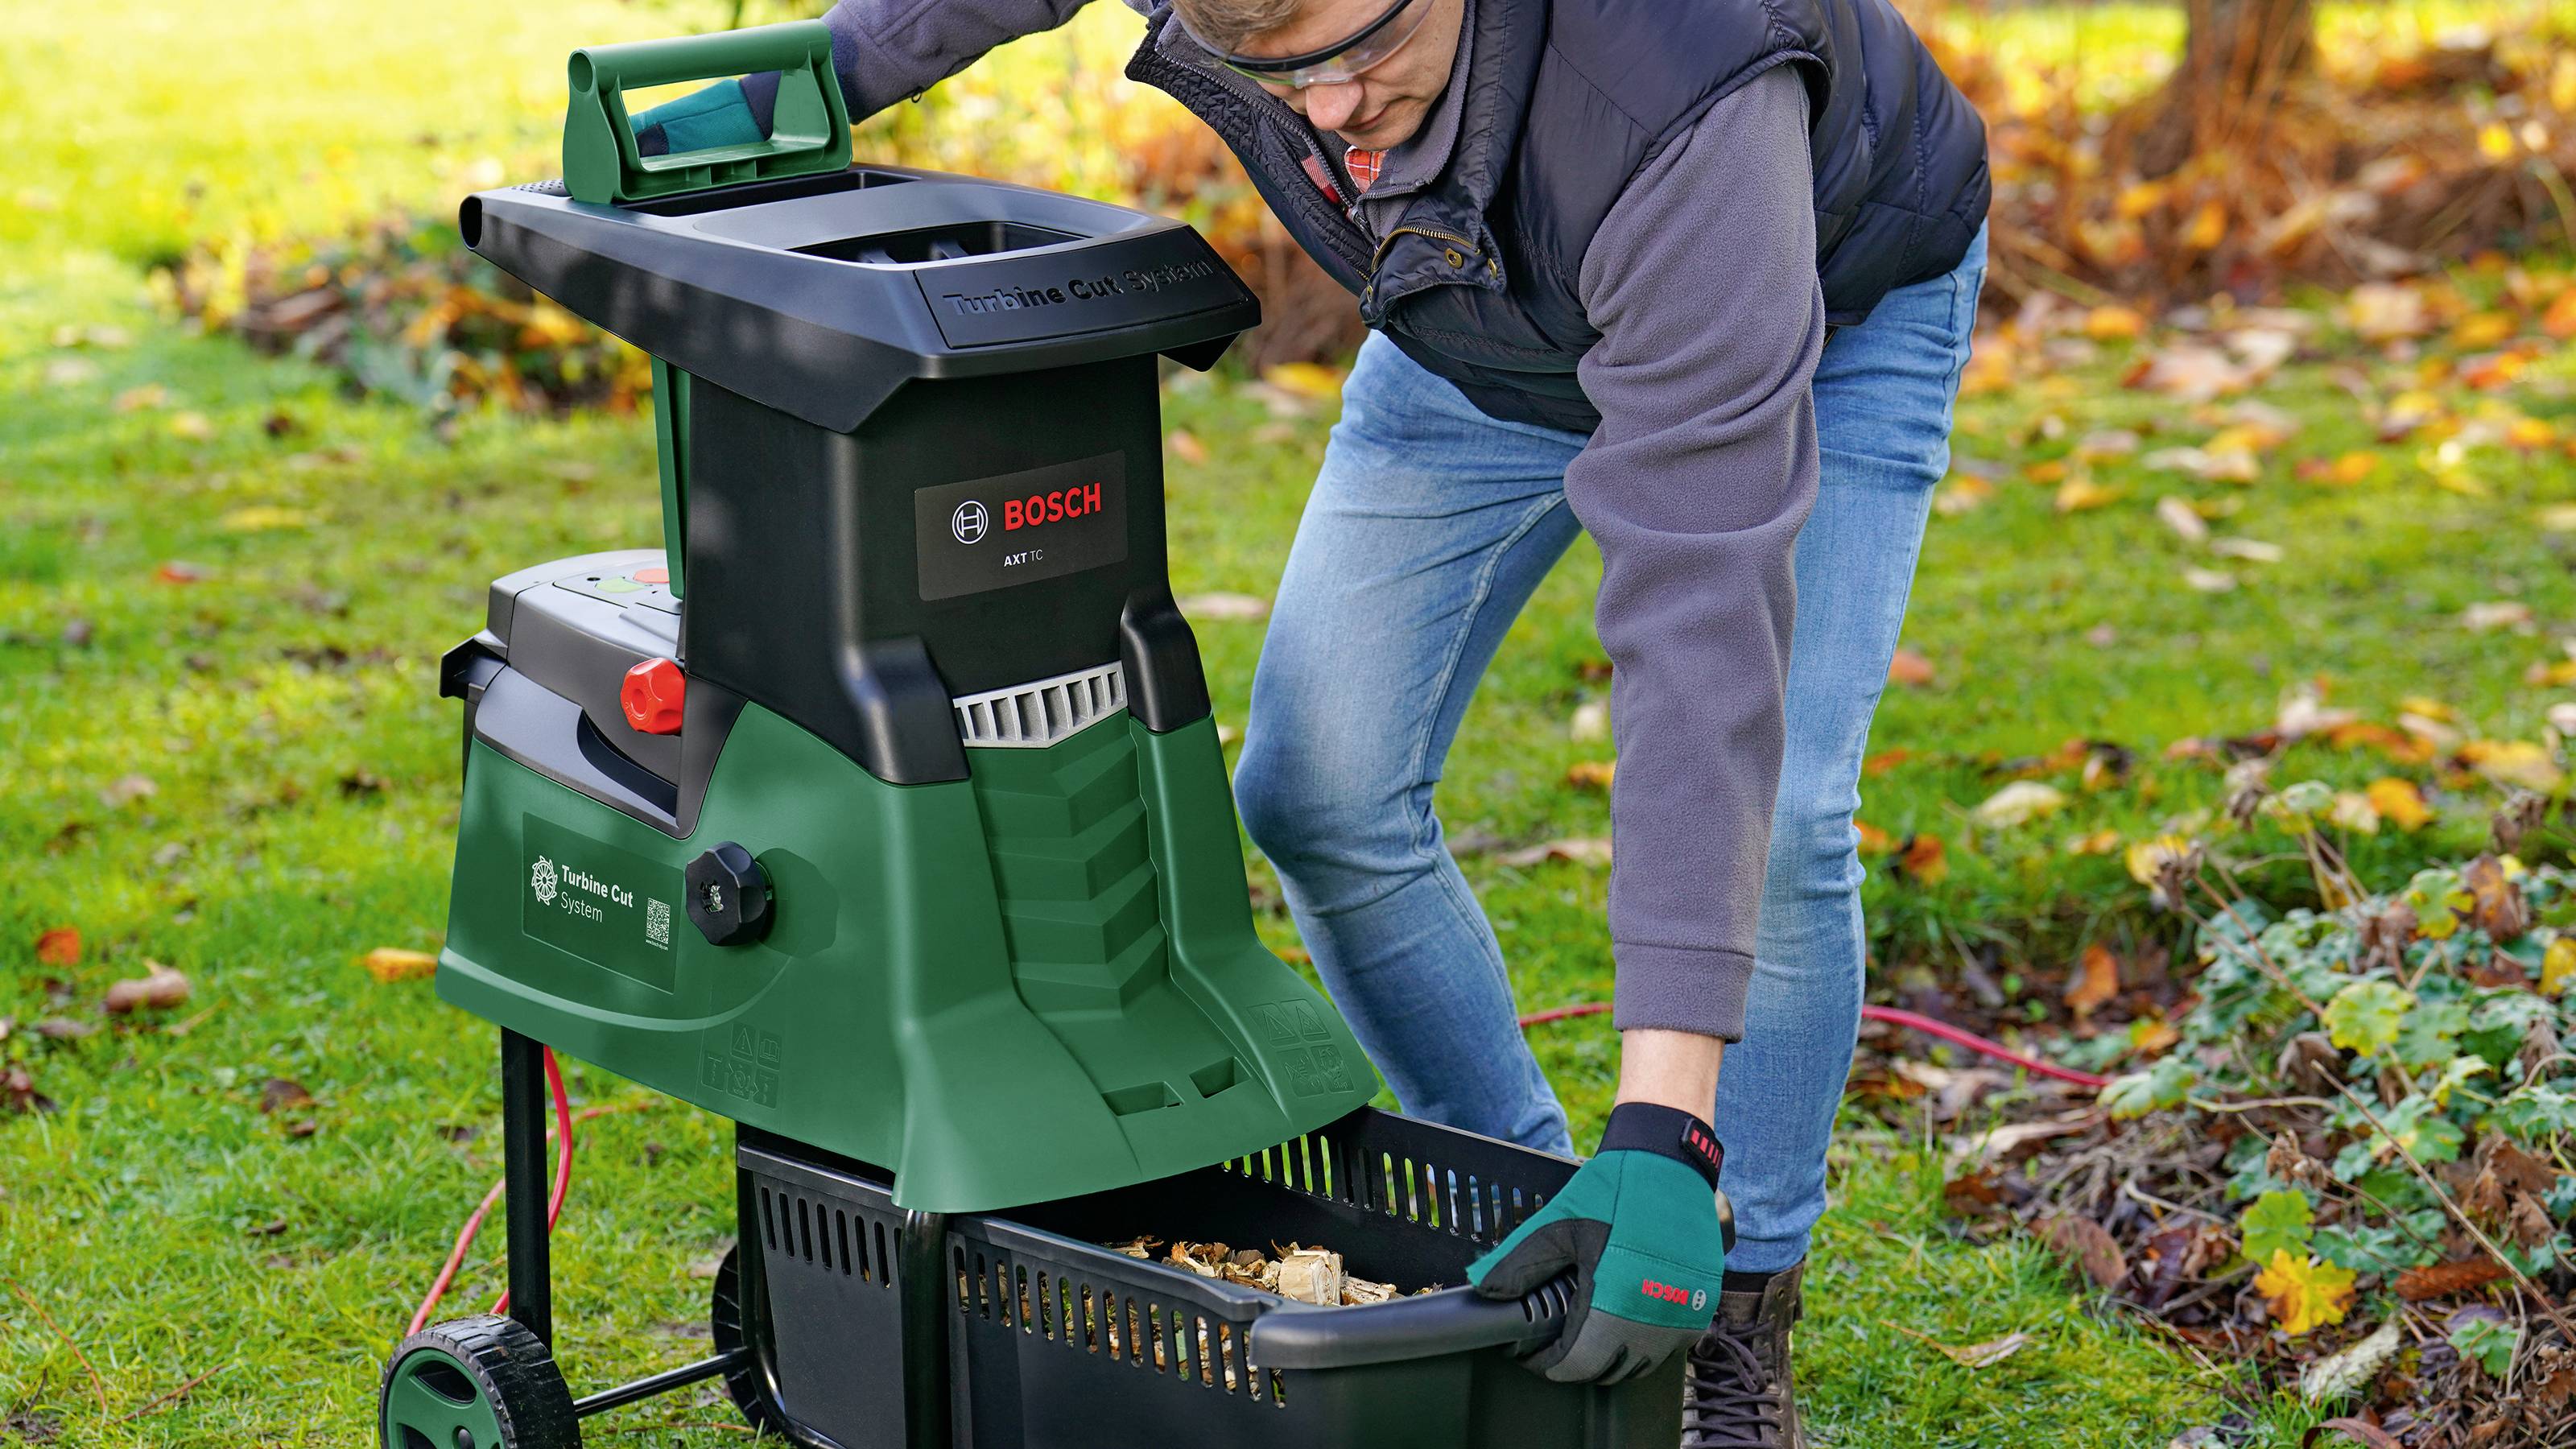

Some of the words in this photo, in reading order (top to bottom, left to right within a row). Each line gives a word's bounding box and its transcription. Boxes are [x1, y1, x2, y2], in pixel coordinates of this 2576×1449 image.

[943, 285, 1067, 316] Turbine
[1068, 275, 1123, 300] Cut
[1122, 259, 1214, 292] System
[1004, 482, 1101, 531] BOSCH
[1004, 552, 1027, 568] AXT
[1030, 549, 1043, 562] TC
[561, 864, 609, 898] Turbine
[611, 884, 634, 909] Cut
[561, 891, 604, 923] System
[1641, 1279, 1690, 1306] BOSCH
